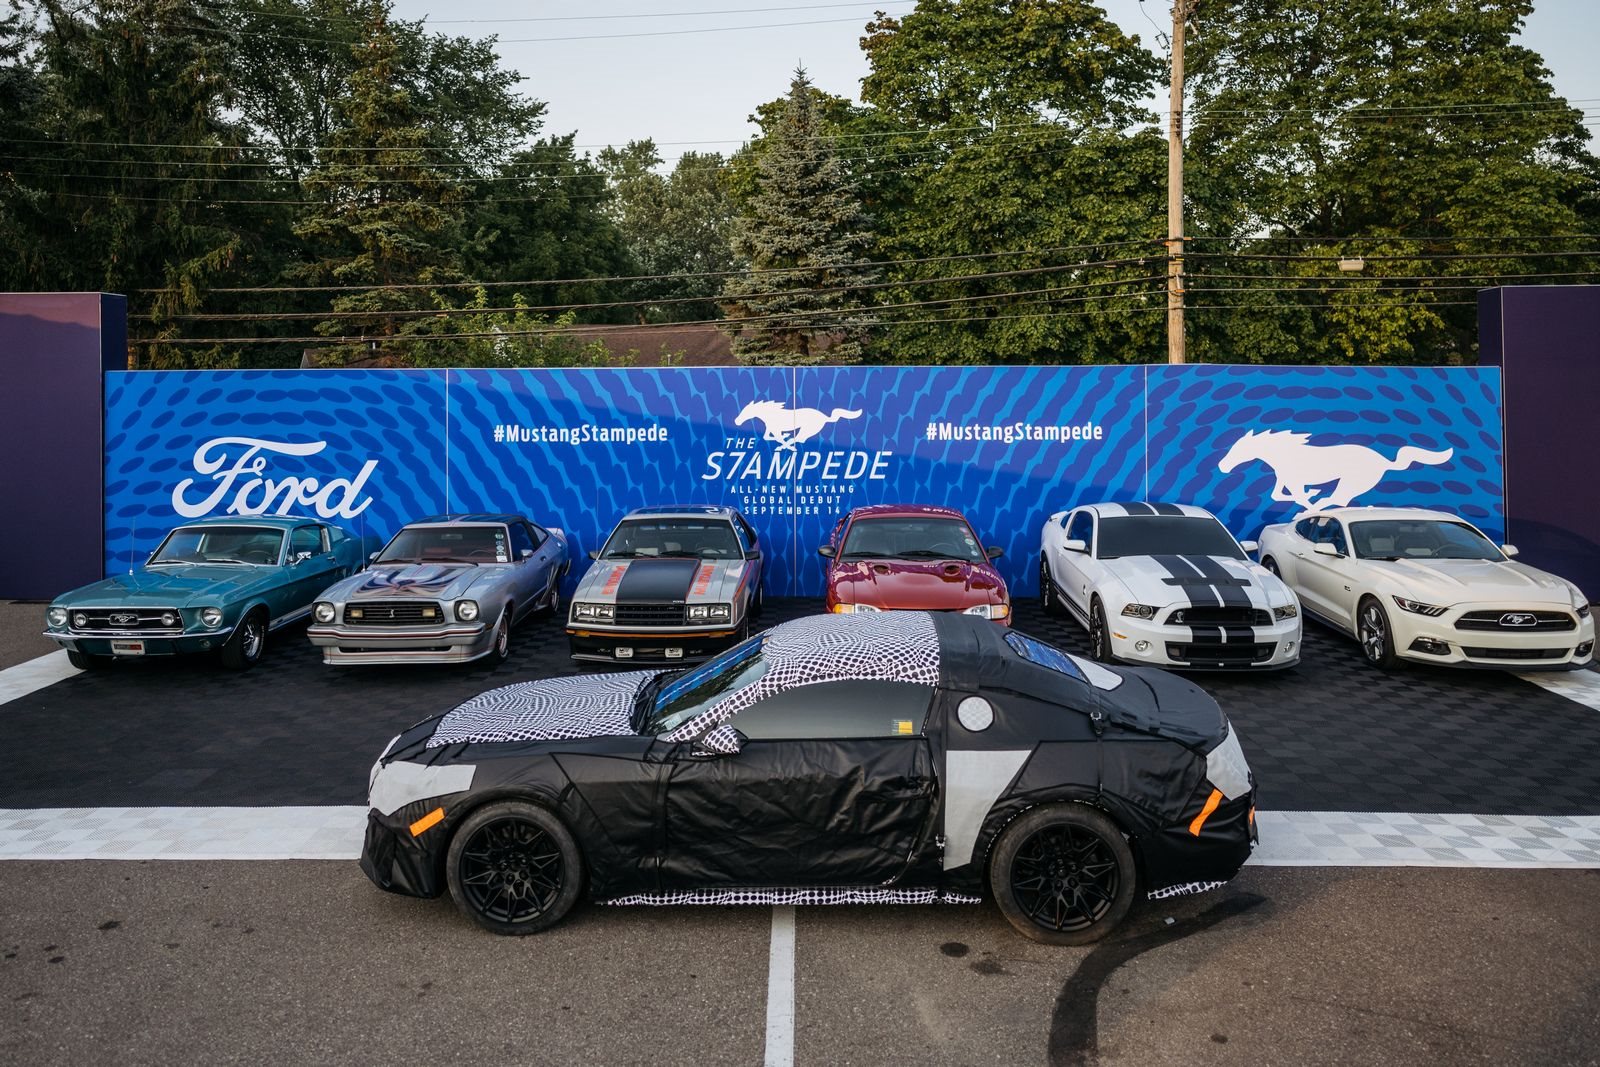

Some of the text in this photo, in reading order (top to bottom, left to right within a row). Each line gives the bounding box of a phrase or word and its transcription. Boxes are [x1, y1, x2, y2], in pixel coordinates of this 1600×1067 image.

[493, 423, 668, 445] #MustangStampede
[926, 421, 1103, 444] #MustangStampede
[725, 437, 756, 449] THE
[701, 451, 893, 480] S7AMPEDE
[171, 436, 379, 518] Ford
[730, 485, 854, 494] ALL-NEW MUSTANG
[744, 495, 841, 504] GLOBAL DEBUT
[744, 506, 840, 515] SEPTEMBER 14
